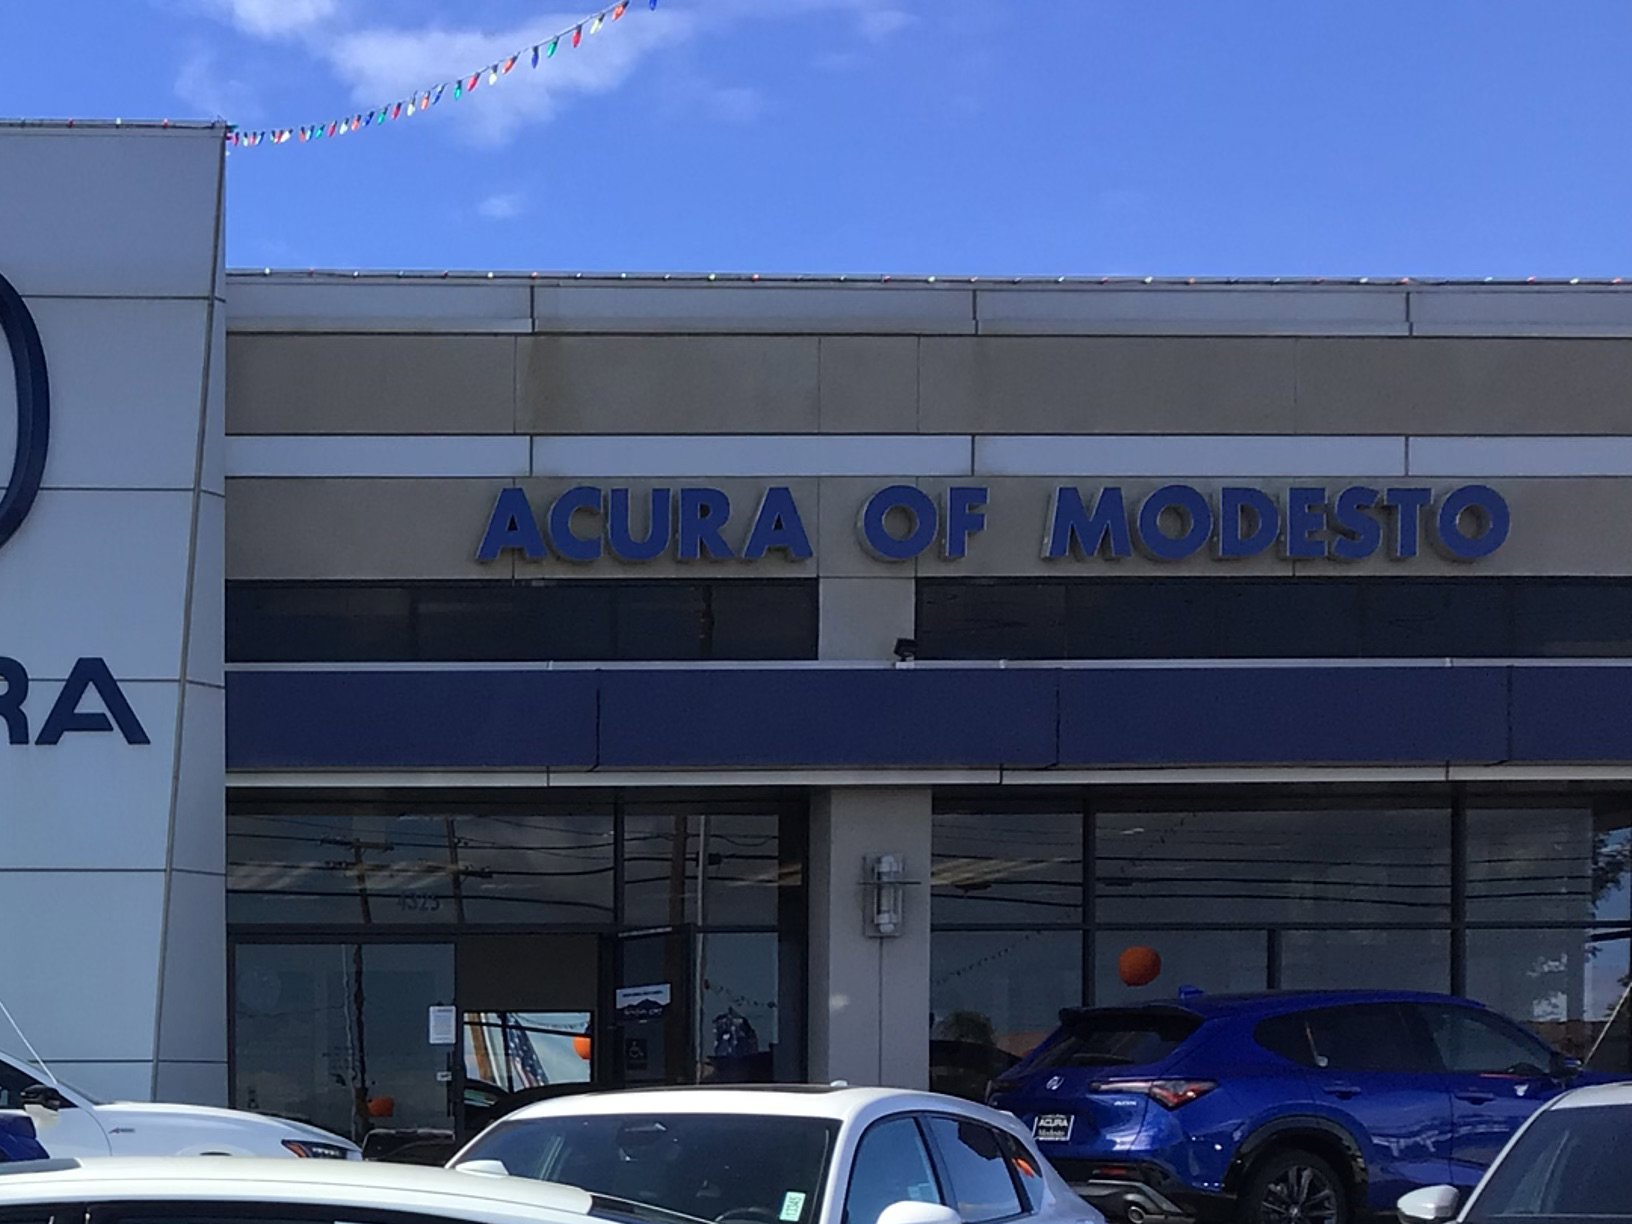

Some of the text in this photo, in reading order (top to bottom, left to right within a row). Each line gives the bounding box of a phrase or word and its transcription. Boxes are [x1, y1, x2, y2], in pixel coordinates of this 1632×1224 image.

[475, 484, 1511, 562] ACURA OF MODESTO
